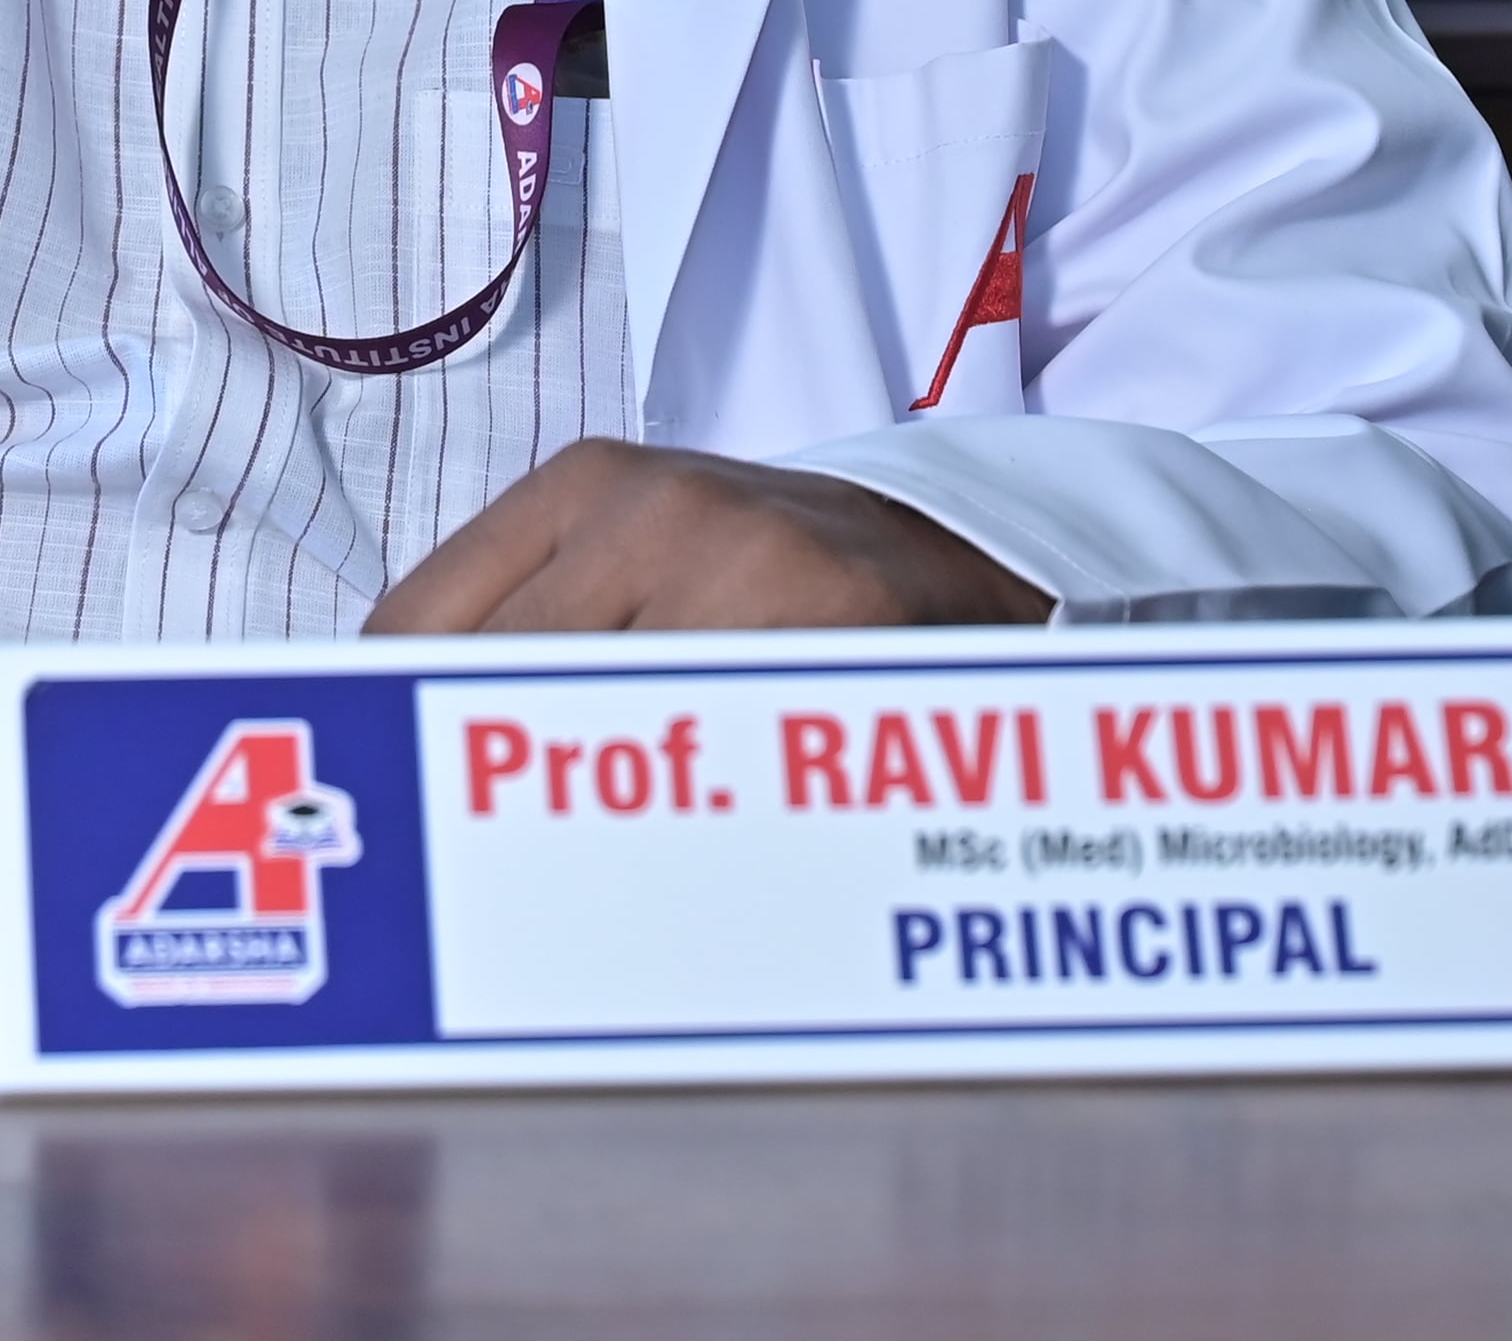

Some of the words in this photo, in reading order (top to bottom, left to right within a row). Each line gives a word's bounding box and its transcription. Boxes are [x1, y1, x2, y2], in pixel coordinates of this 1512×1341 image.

[462, 714, 735, 815] Prof.
[778, 708, 1047, 809] RAVI
[914, 829, 1008, 871] MSc
[1020, 825, 1145, 879] (Med)
[1157, 823, 1436, 875] Microbiology,
[892, 899, 1380, 985] PRINCIPAL
